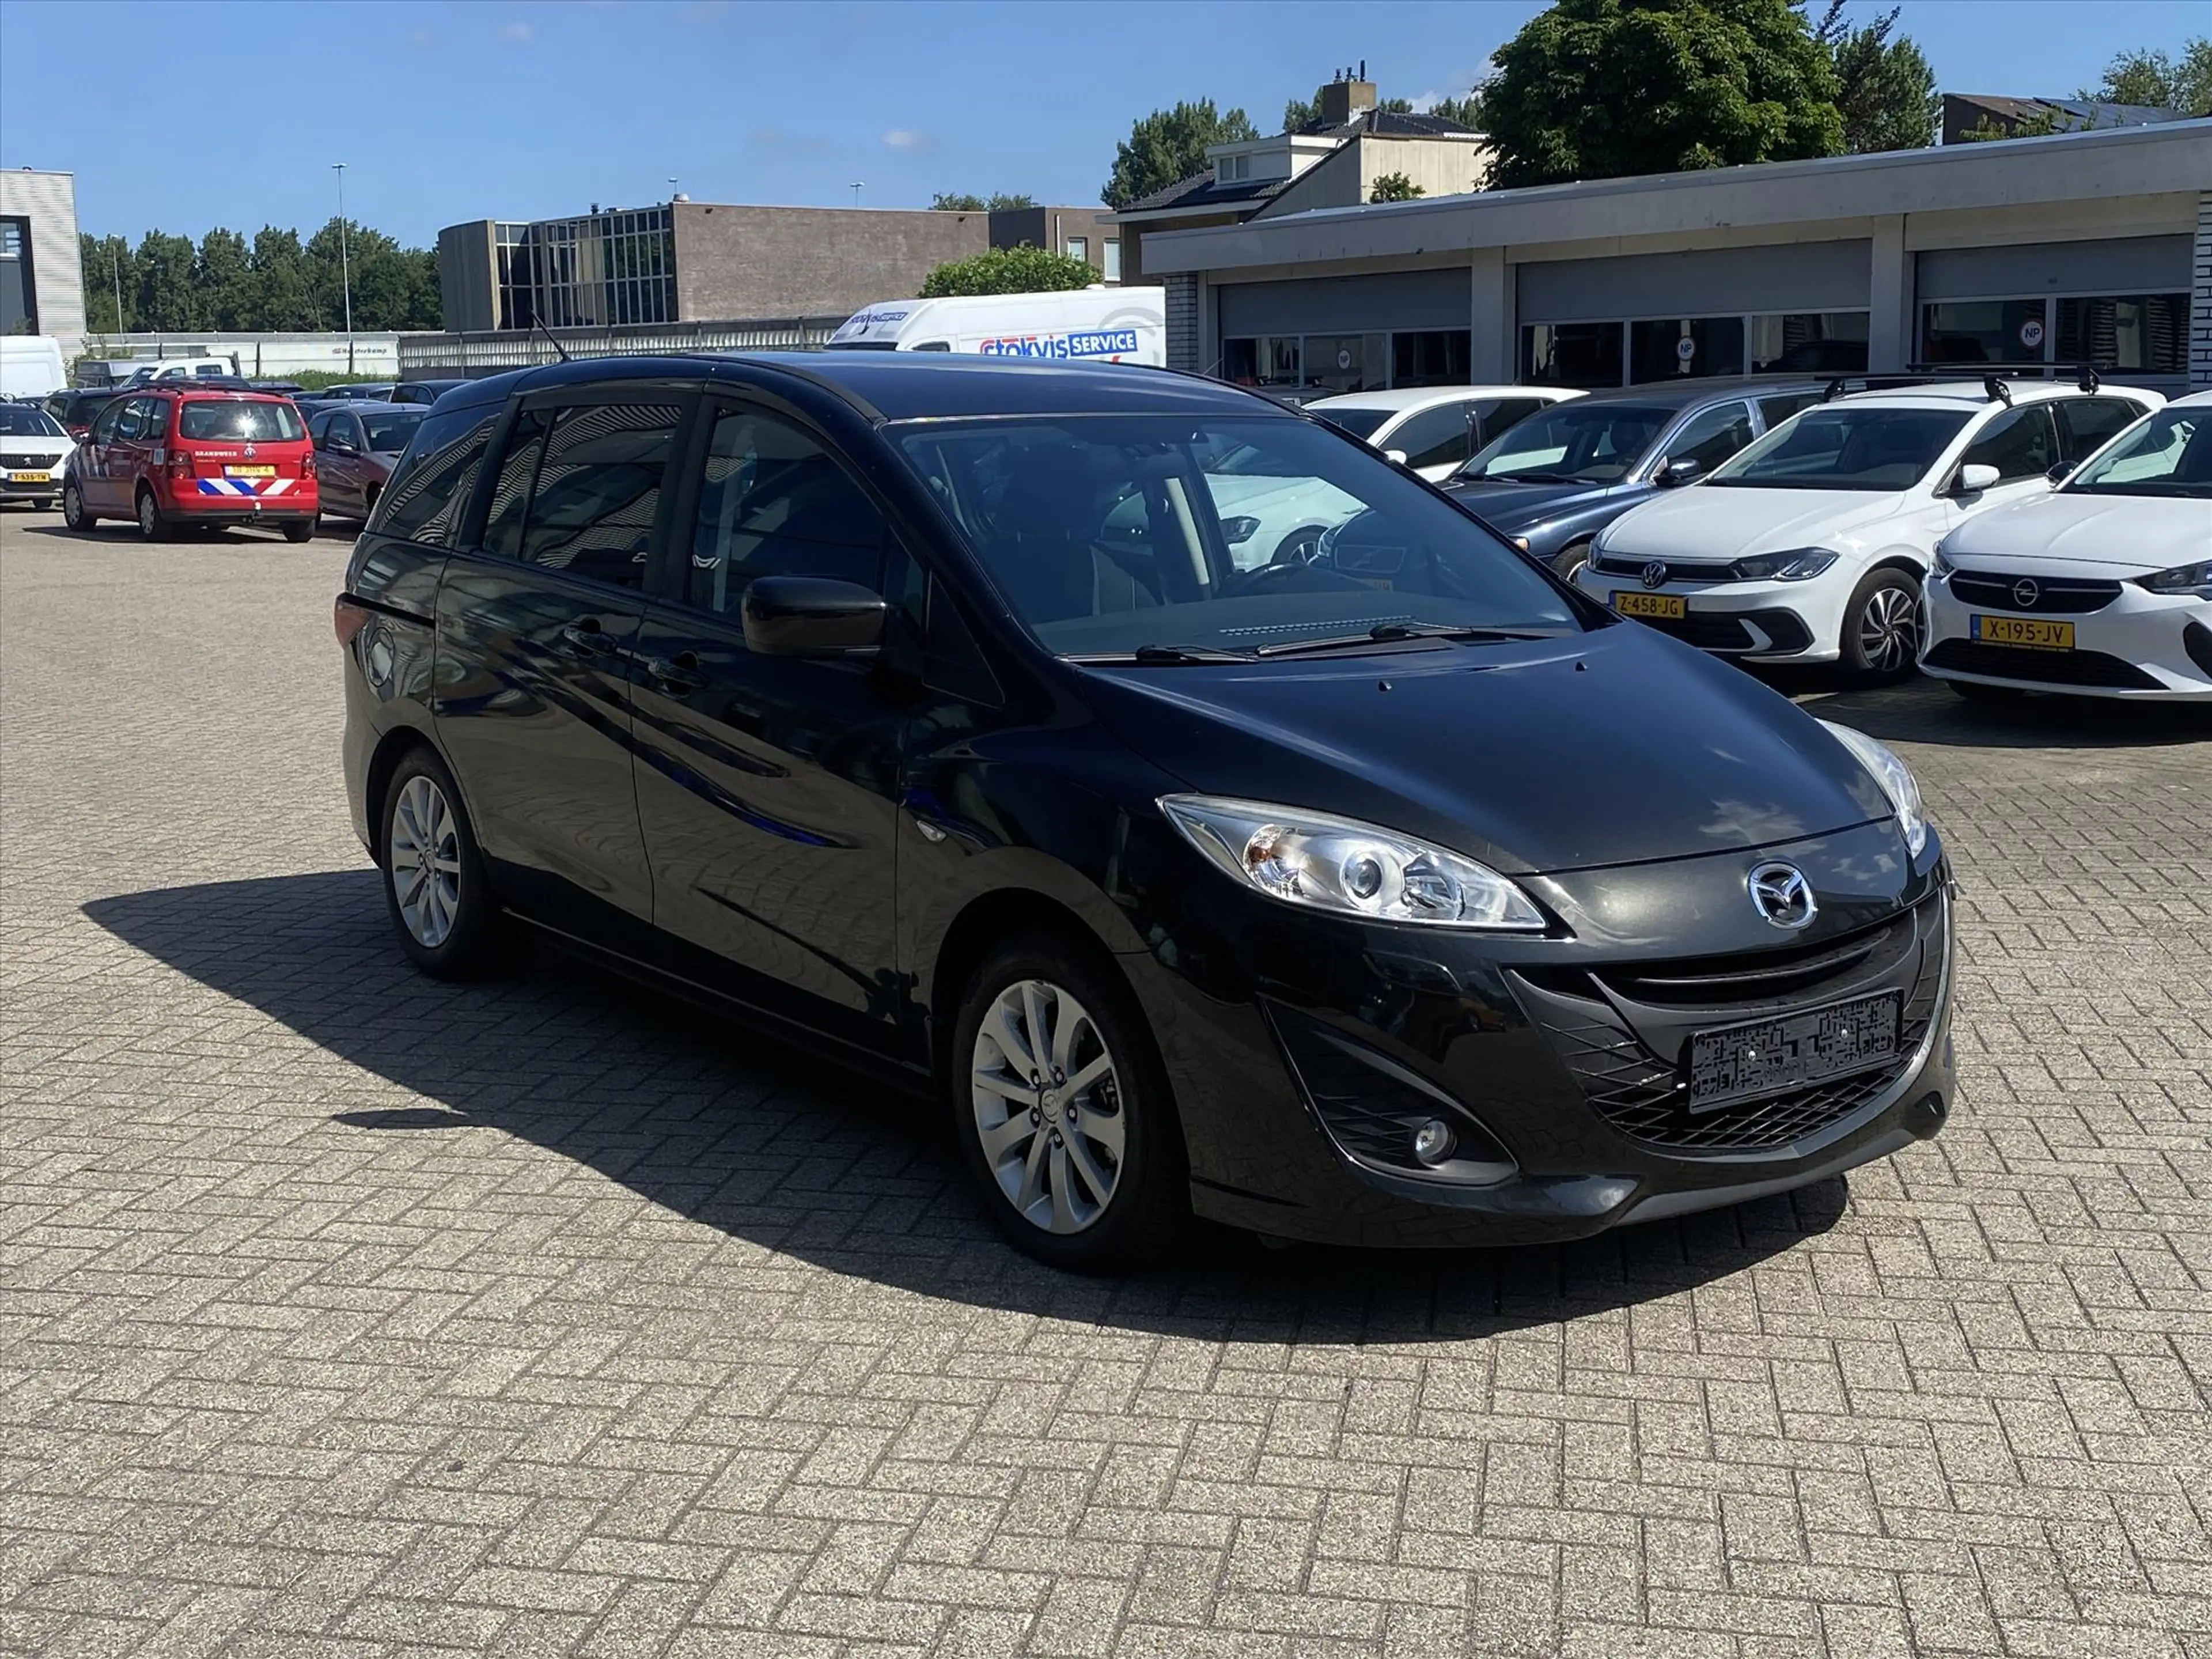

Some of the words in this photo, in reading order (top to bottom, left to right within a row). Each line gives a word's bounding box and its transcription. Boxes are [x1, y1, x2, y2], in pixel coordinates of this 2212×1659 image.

[1072, 332, 1135, 354] SERVICE
[2025, 328, 2040, 338] NP
[1619, 596, 1679, 615] Z-458-JG
[1990, 620, 2064, 643] X-195-JV
